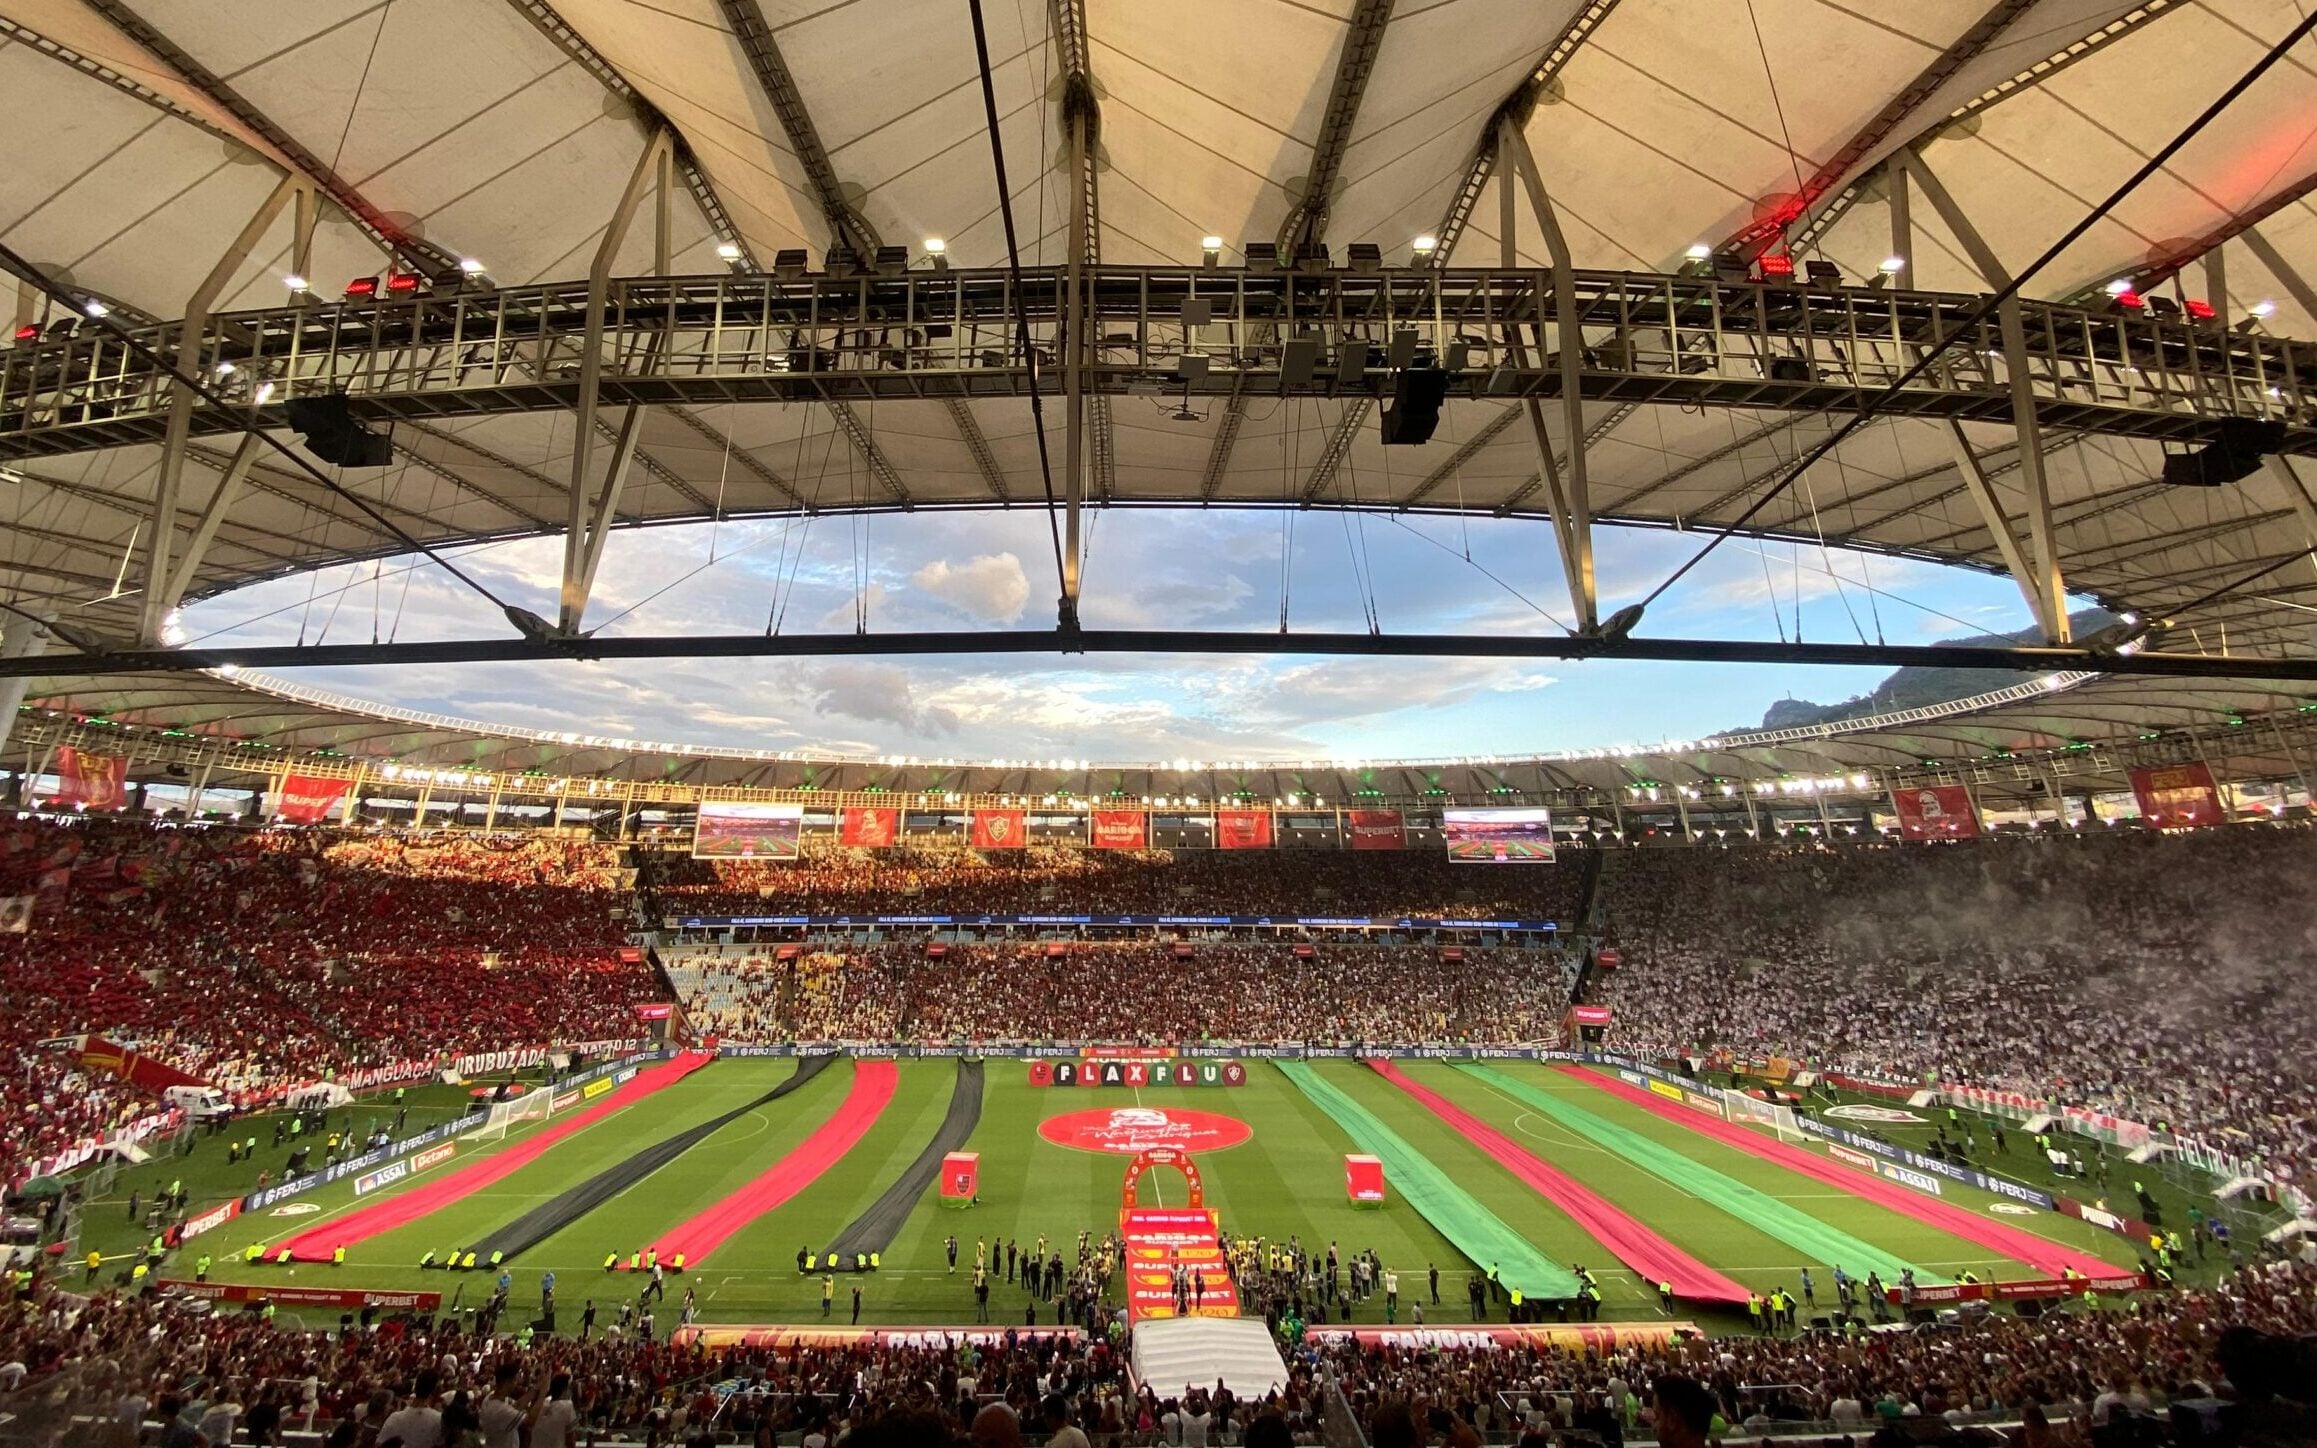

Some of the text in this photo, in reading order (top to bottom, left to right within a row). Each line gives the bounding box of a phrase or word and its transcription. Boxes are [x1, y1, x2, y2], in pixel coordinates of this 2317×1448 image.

[1355, 826, 1400, 835] SUPERBET
[1550, 1051, 1570, 1059] FERJ
[406, 1134, 427, 1151] FERJ
[1860, 1136, 1881, 1153] FERJ
[346, 1155, 368, 1172] FERJ
[417, 1147, 453, 1168] Betano
[1829, 1145, 1872, 1168] SUPERBET
[1924, 1157, 1949, 1176] FERJ
[275, 1178, 302, 1200] FERJ
[2000, 1180, 2027, 1200] FERJ
[180, 1202, 233, 1239] UPERBET
[364, 1293, 419, 1307] SUPERBET
